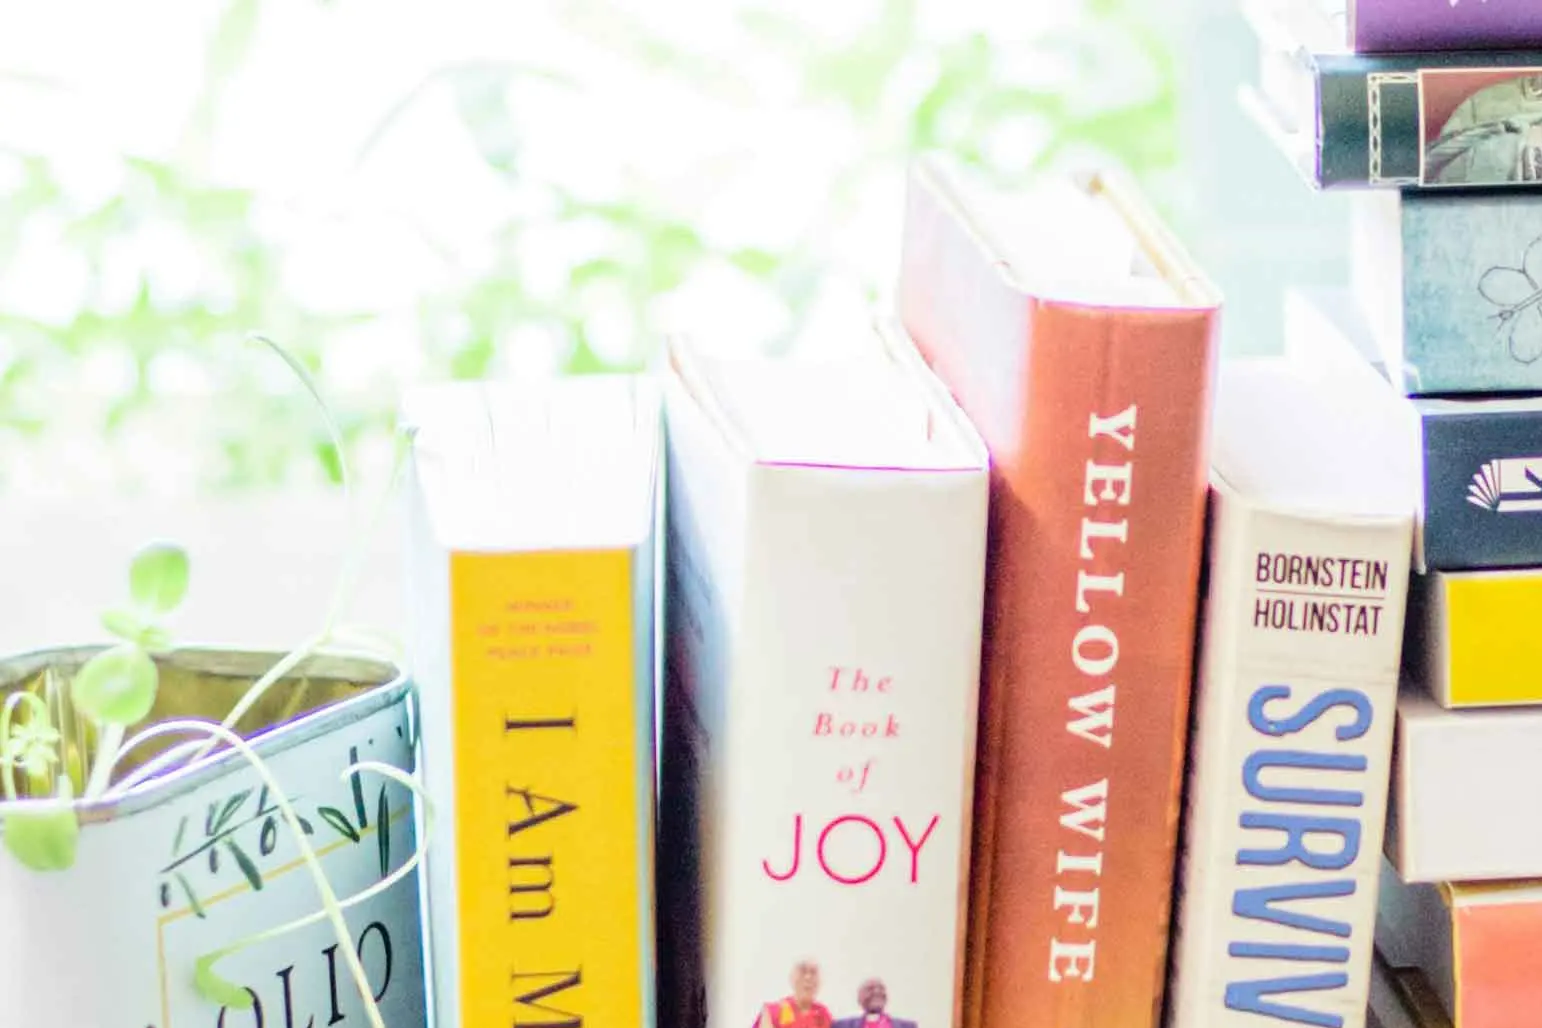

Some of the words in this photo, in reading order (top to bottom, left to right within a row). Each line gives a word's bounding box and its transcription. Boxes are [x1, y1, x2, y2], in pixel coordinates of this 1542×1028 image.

[1064, 403, 1138, 750] YELLOW
[1256, 552, 1388, 592] BORNSTEIN
[1253, 598, 1385, 637] HOLINSTAT
[829, 664, 894, 693] The
[503, 709, 577, 739] I
[813, 711, 901, 739] Book
[836, 756, 878, 794] of
[504, 780, 580, 924] Am
[762, 812, 942, 886] JOY
[1047, 778, 1110, 984] WIFE
